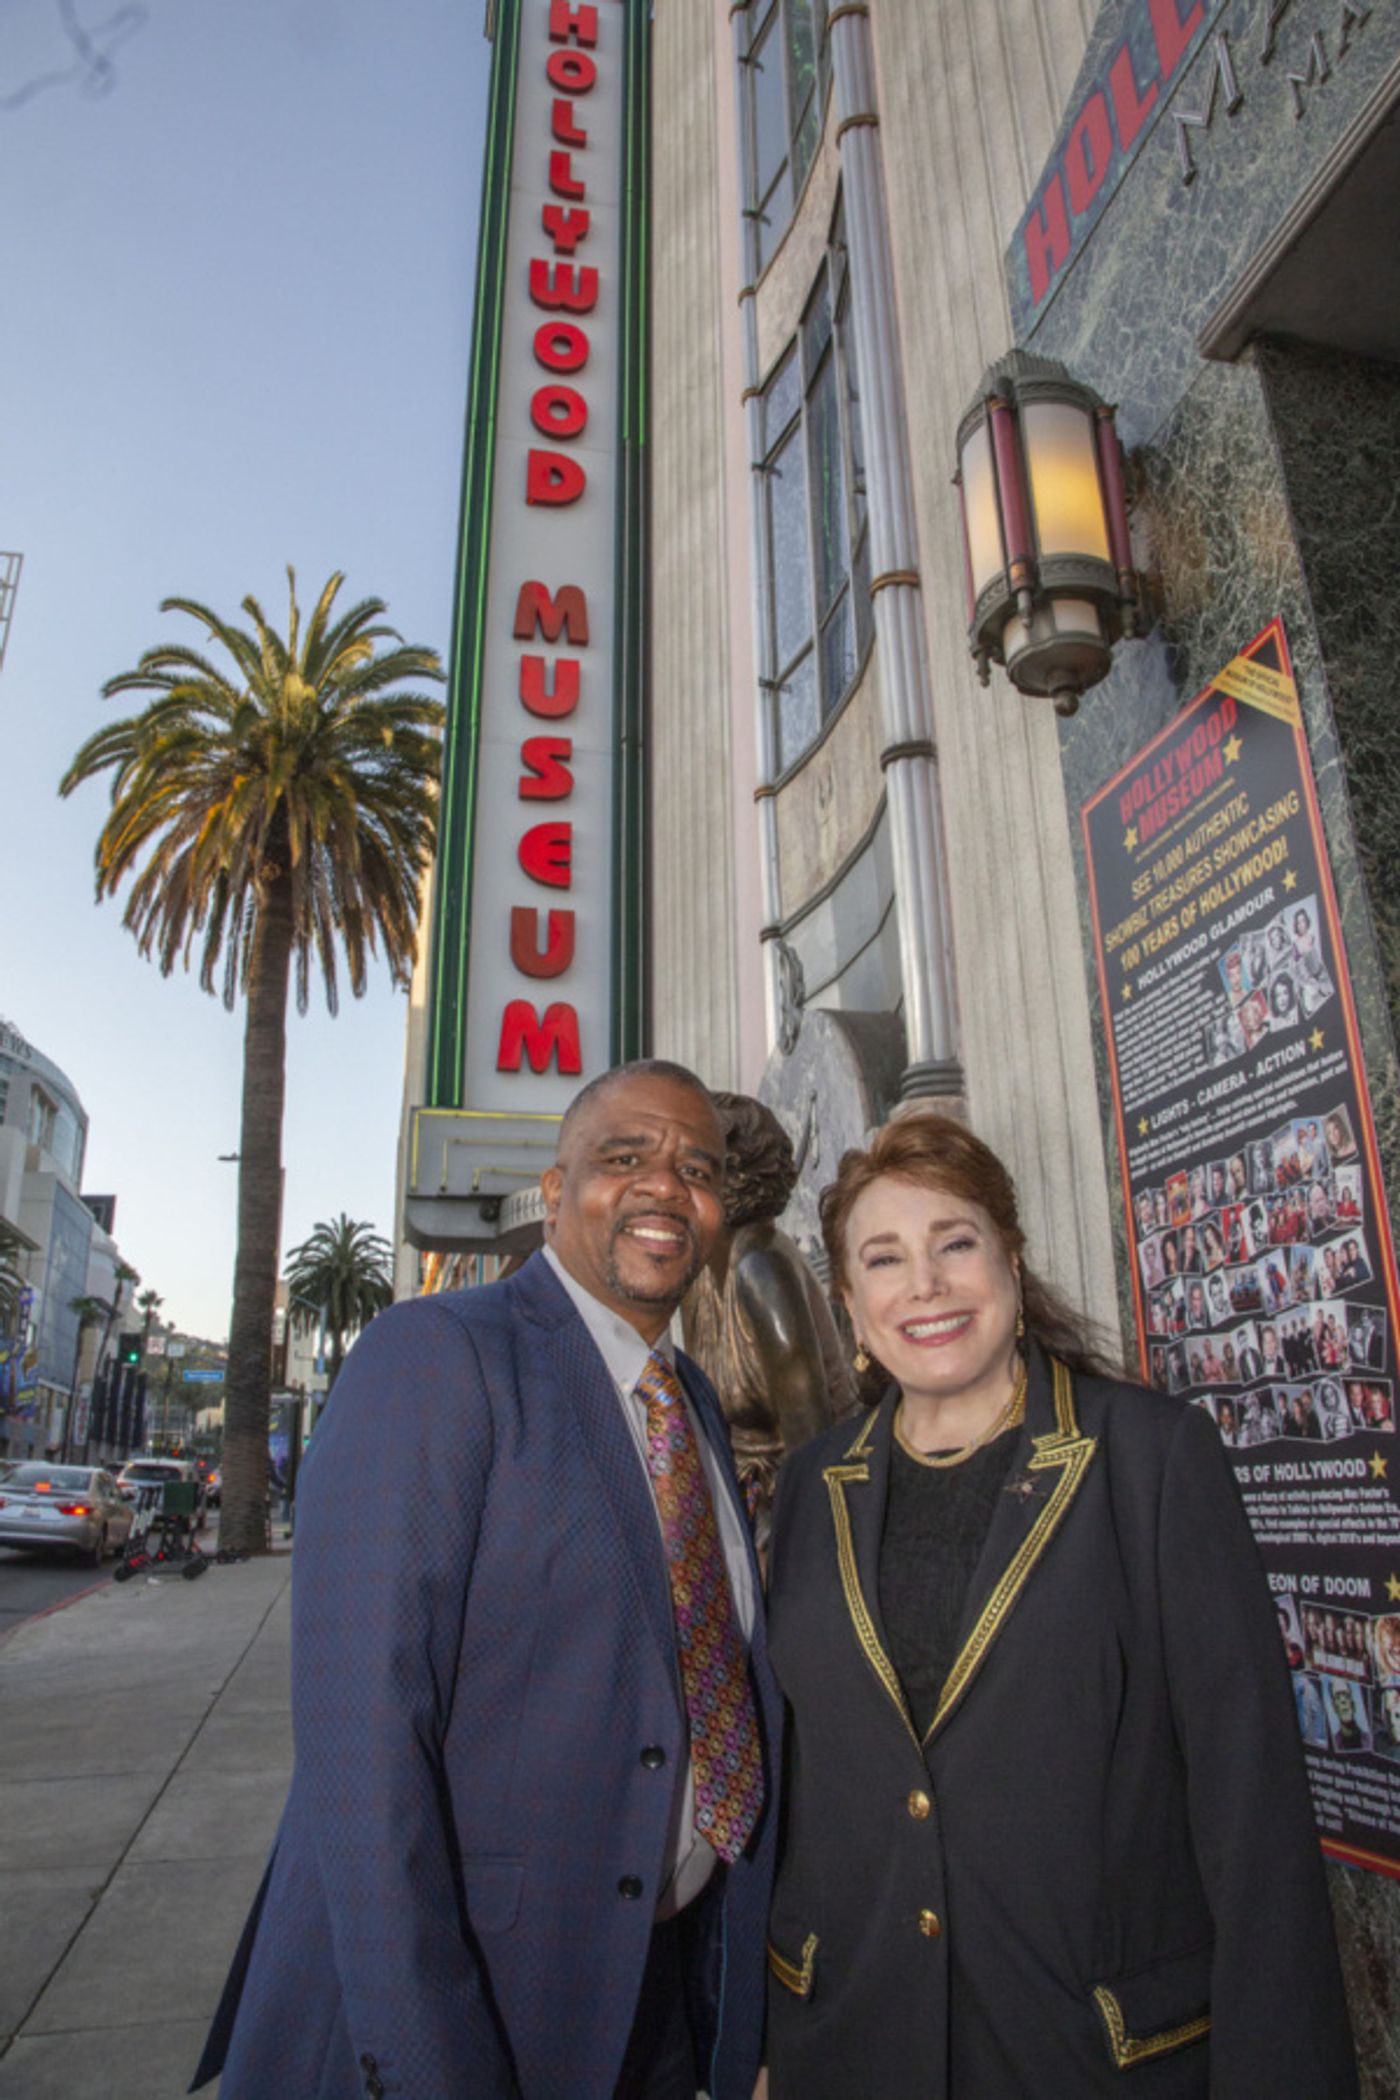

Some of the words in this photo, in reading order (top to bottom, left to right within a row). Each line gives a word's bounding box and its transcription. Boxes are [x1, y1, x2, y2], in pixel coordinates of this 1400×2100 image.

[526, 0, 600, 508] HOLLYWOOD
[1119, 696, 1237, 824] HOLLYWOOD
[1140, 748, 1222, 841] MUSEUM
[495, 579, 590, 1077] MUSEUM
[1106, 905, 1149, 952] SHOWBIZ
[1148, 856, 1212, 914] TREASURES
[1214, 790, 1299, 870] SHOWCASING
[1132, 870, 1152, 900] SEE
[1186, 792, 1249, 857] AUTHENTIC
[1121, 944, 1140, 970] 100
[1142, 916, 1180, 955] YEARS
[1181, 901, 1197, 928] OF
[1200, 836, 1288, 915] HOLLYWOOD!
[1138, 933, 1208, 990] HOLLYWOOD
[1210, 887, 1275, 940] GLAMOUR
[1151, 1099, 1190, 1129] LIGHTS
[1197, 1071, 1247, 1106] CAMERA
[1256, 1040, 1306, 1077] ACTION
[1253, 1465, 1271, 1483] OF
[1273, 1458, 1367, 1482] HOLLYWOOD
[1300, 1574, 1320, 1594] OF
[1323, 1575, 1371, 1598] DOOM
